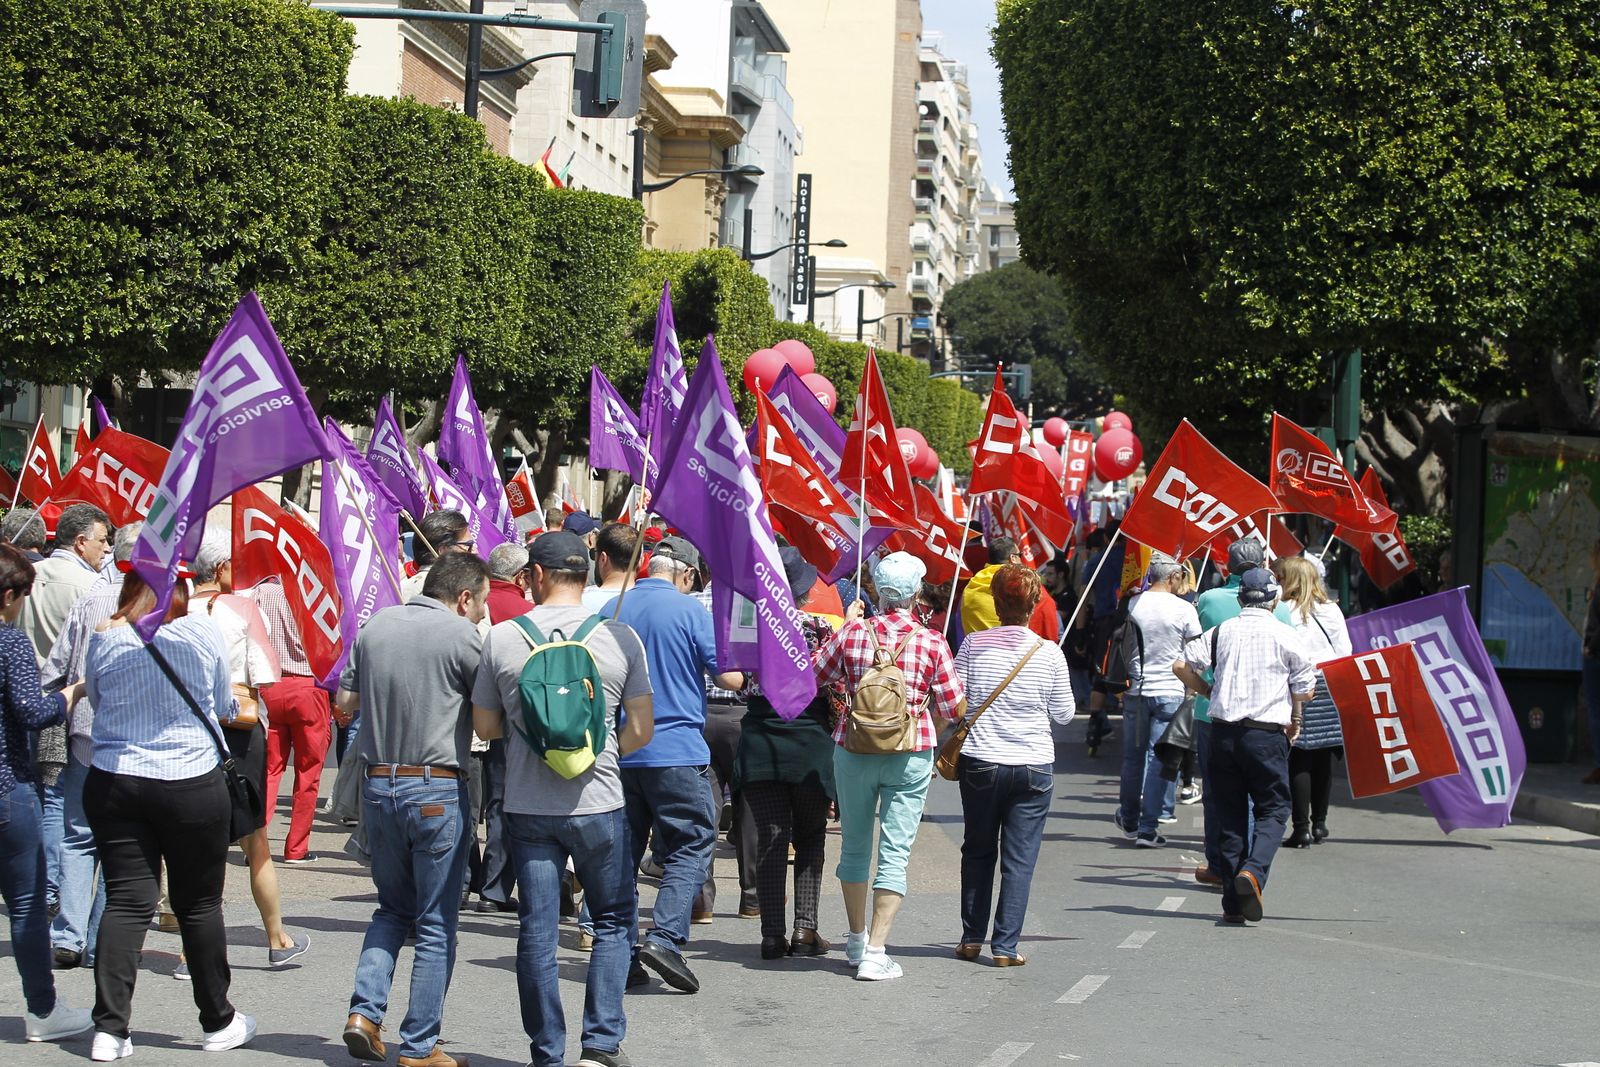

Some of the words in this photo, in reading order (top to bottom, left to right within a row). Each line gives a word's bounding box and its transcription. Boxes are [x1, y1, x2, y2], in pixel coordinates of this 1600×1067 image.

[800, 179, 808, 223] hotel
[1068, 439, 1089, 491] UGT
[243, 508, 341, 645] CCOO
[756, 597, 809, 672] Andalucía
[1353, 652, 1420, 784] CCOO
[1413, 631, 1499, 761] CCOO
